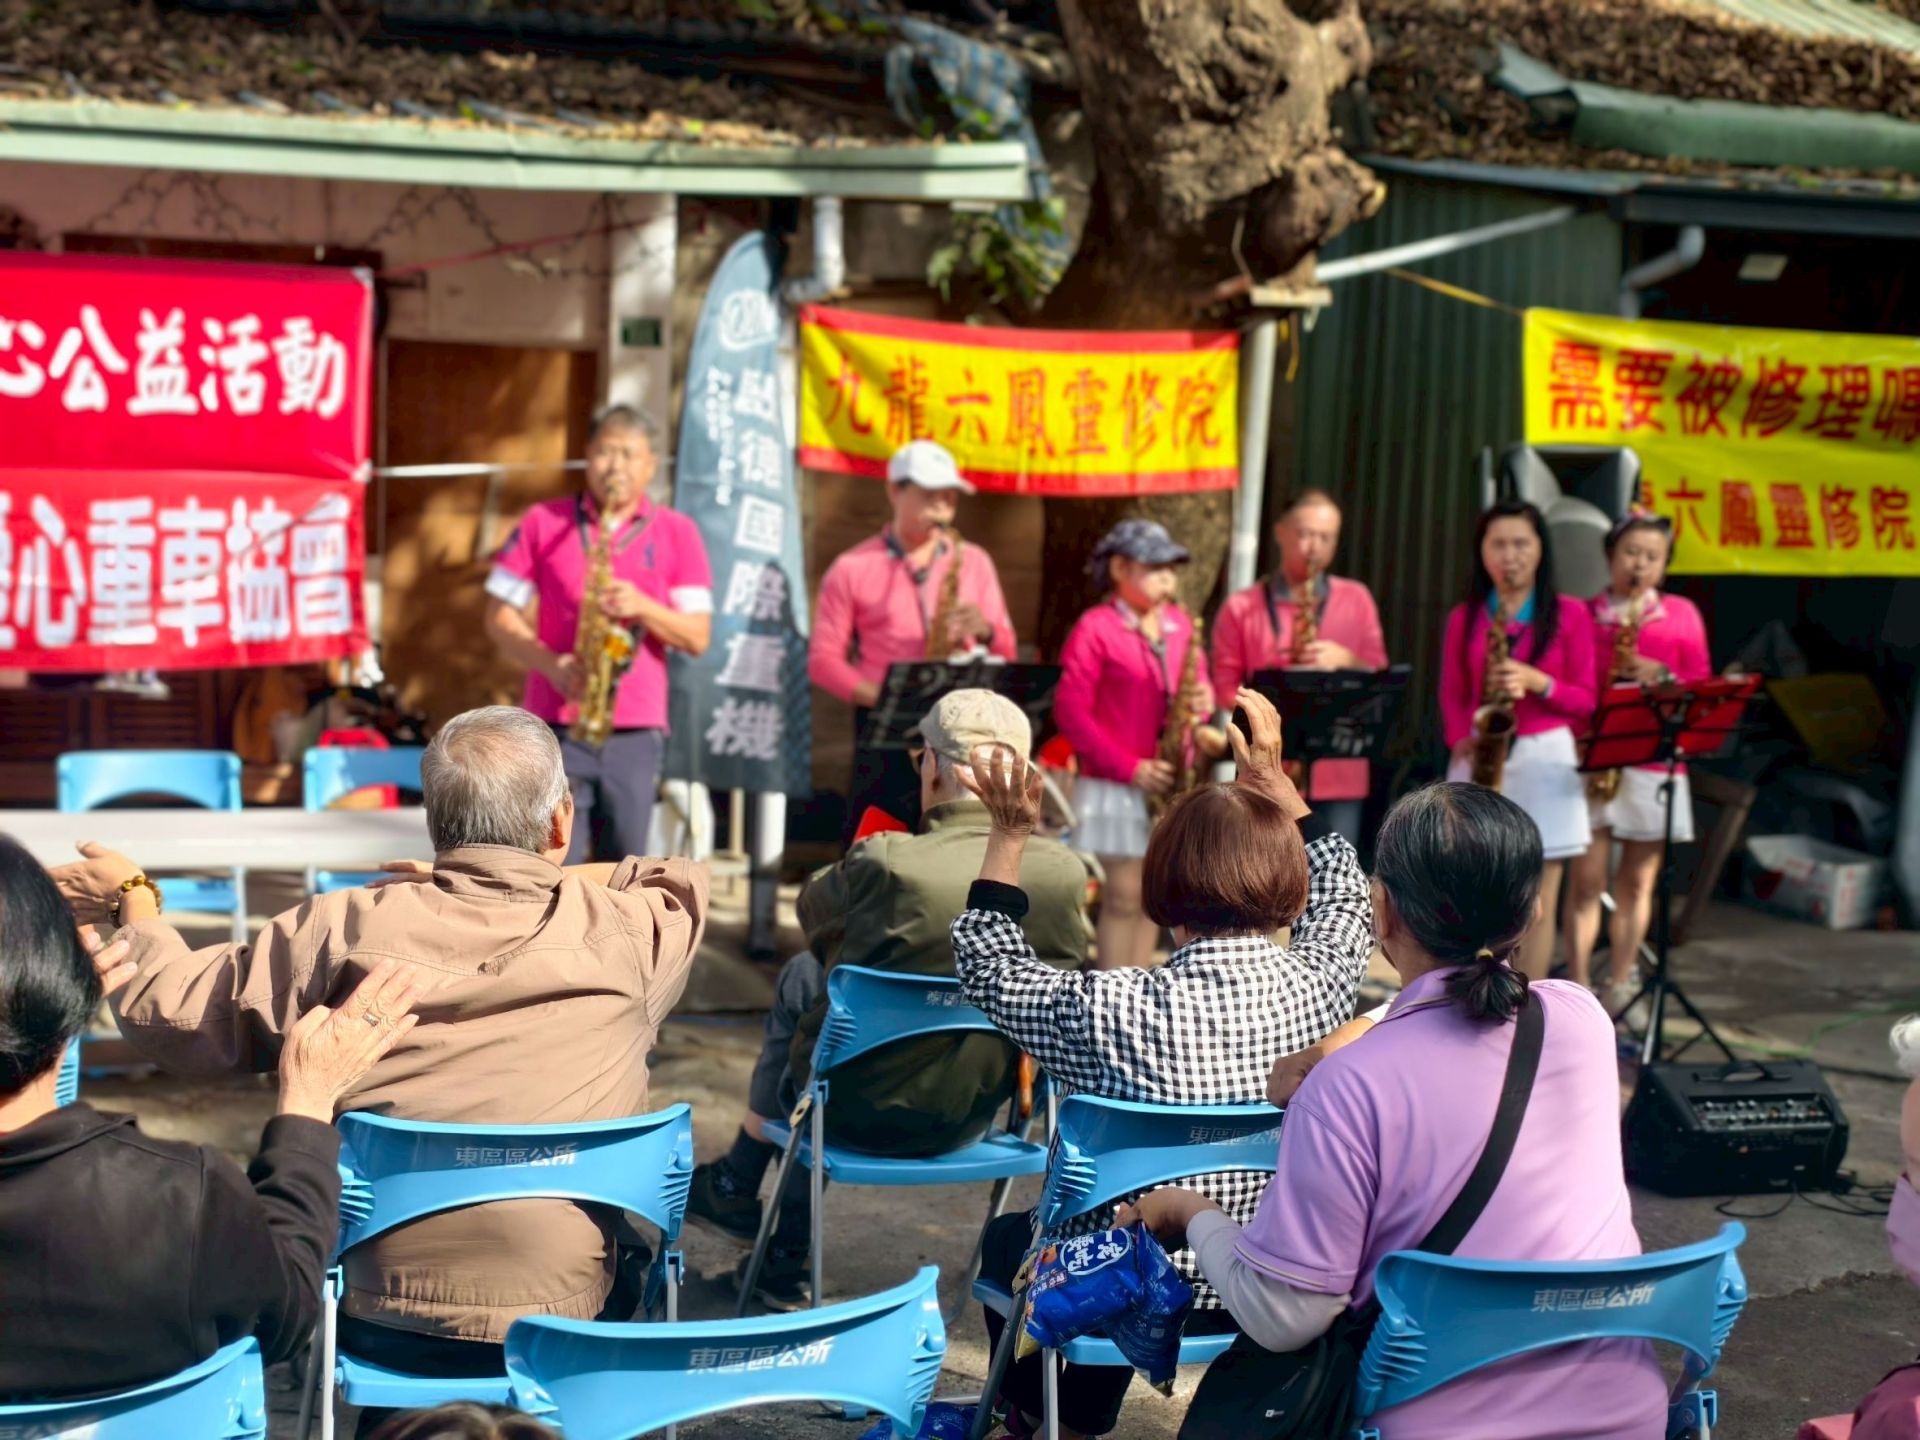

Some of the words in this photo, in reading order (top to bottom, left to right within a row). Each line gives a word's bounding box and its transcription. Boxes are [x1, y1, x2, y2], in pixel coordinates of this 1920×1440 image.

[1641, 477, 1915, 550] 六鳳靈修院
[0, 493, 349, 648] 心重車協會
[455, 1142, 578, 1168] 東區區公所
[1531, 1282, 1655, 1312] 東區區公所
[686, 1336, 836, 1374] 東區區公所
